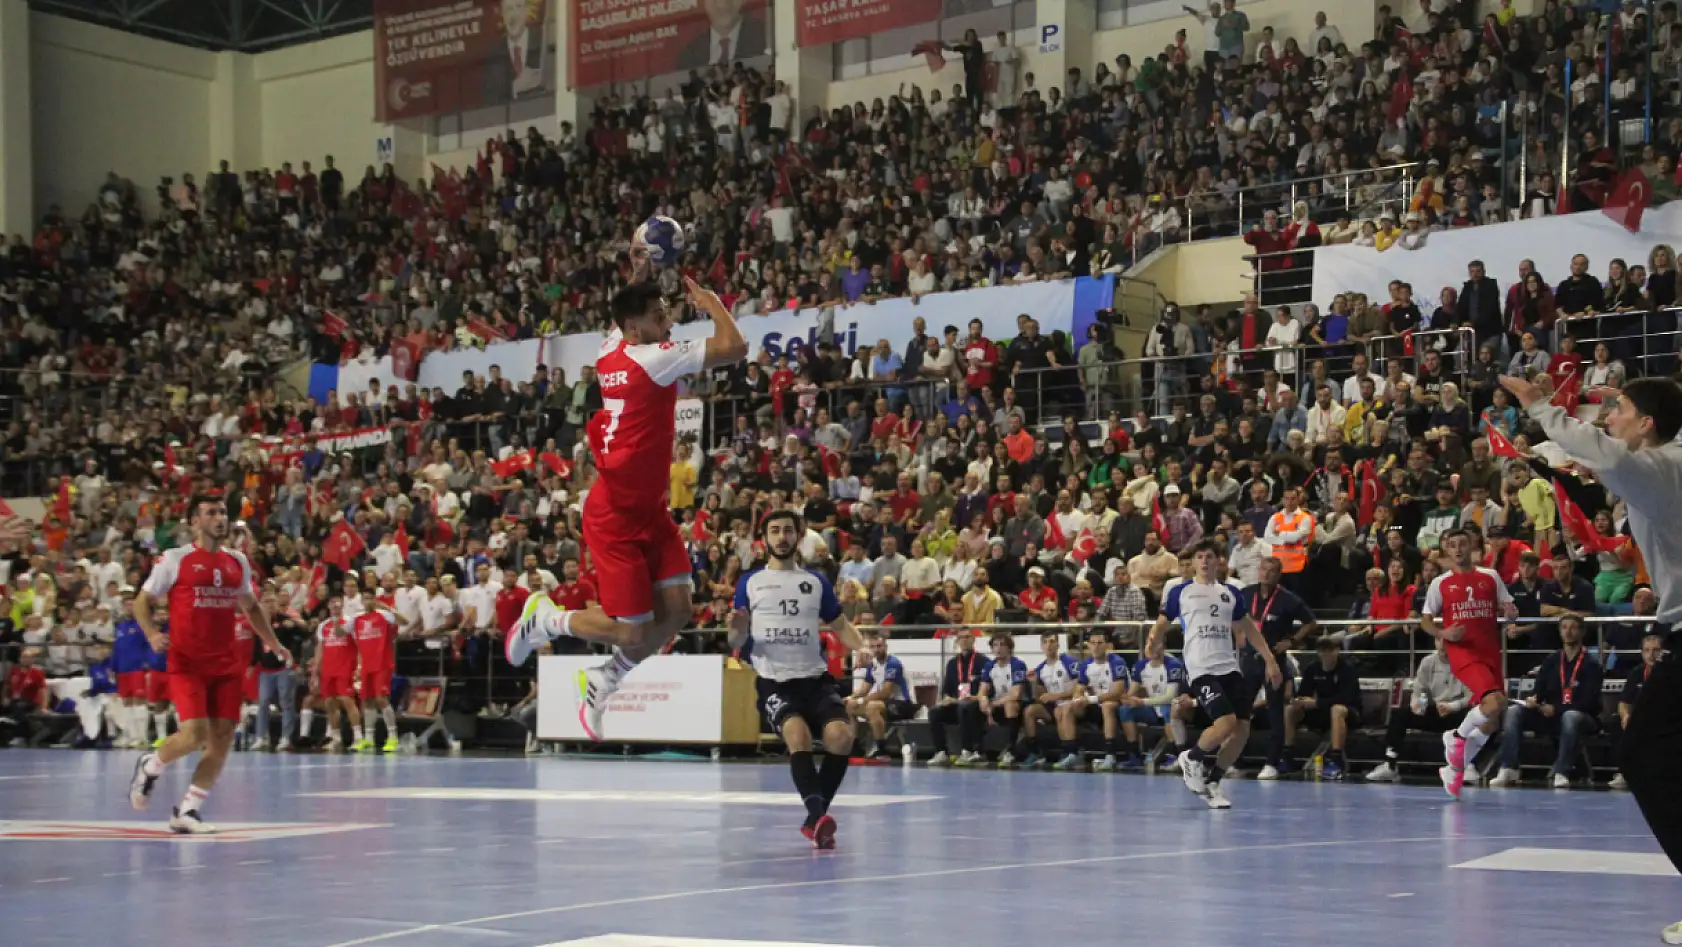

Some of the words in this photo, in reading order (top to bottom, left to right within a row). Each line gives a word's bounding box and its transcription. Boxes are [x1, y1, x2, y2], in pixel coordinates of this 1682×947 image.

[1043, 25, 1058, 44] P
[377, 137, 391, 152] M
[604, 398, 625, 454] 7
[213, 568, 222, 587] 8
[1466, 585, 1475, 602] 2
[778, 598, 800, 616] 13
[1209, 604, 1219, 617] 2
[765, 627, 810, 637] ITALIA
[1201, 685, 1214, 700] 2
